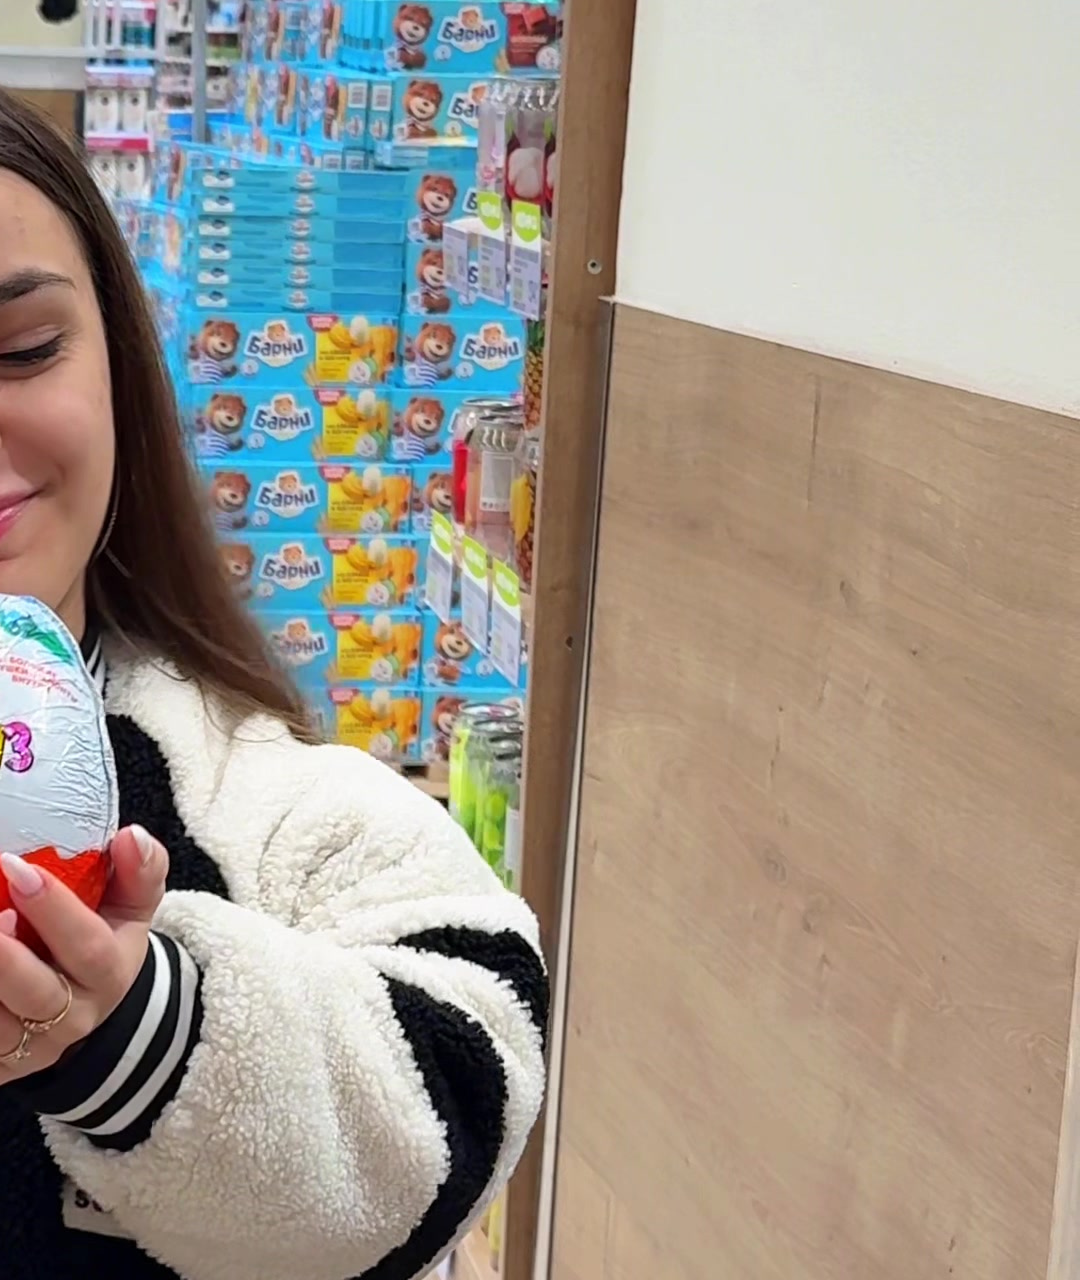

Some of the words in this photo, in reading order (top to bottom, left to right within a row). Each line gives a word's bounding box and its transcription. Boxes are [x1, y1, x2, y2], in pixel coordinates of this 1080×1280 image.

[442, 21, 496, 42] Барни
[247, 335, 304, 357] Барни
[463, 338, 519, 359] Барни
[254, 410, 311, 431] Барни
[258, 487, 316, 508] Барни
[263, 559, 321, 579] Барни
[273, 634, 325, 655] арни
